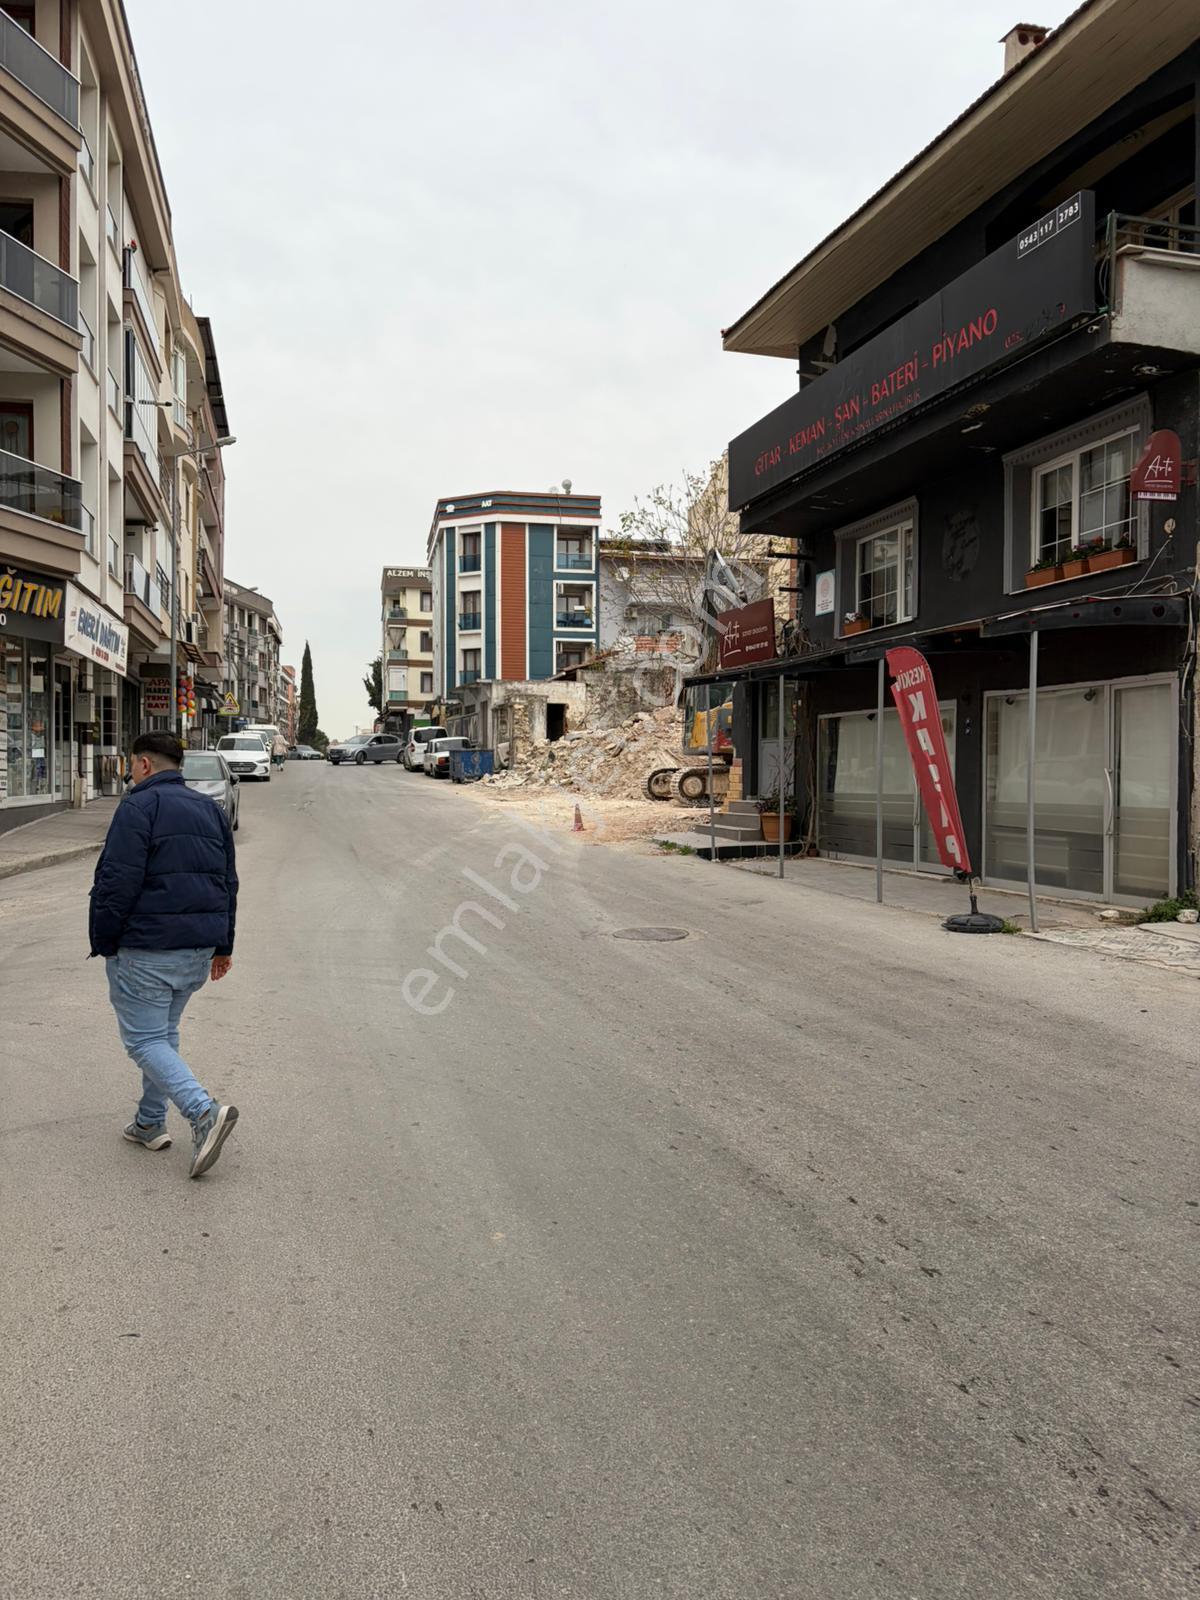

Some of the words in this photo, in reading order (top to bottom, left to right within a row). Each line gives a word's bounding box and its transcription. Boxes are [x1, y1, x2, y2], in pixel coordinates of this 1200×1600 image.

[1020, 231, 1038, 250] 0543
[1040, 219, 1053, 236] 117
[755, 445, 781, 476] GİTAR
[789, 416, 826, 456] KEMAN
[871, 351, 918, 407] BATERİ
[931, 307, 998, 369] PİYANO
[386, 569, 414, 578] ALZEM
